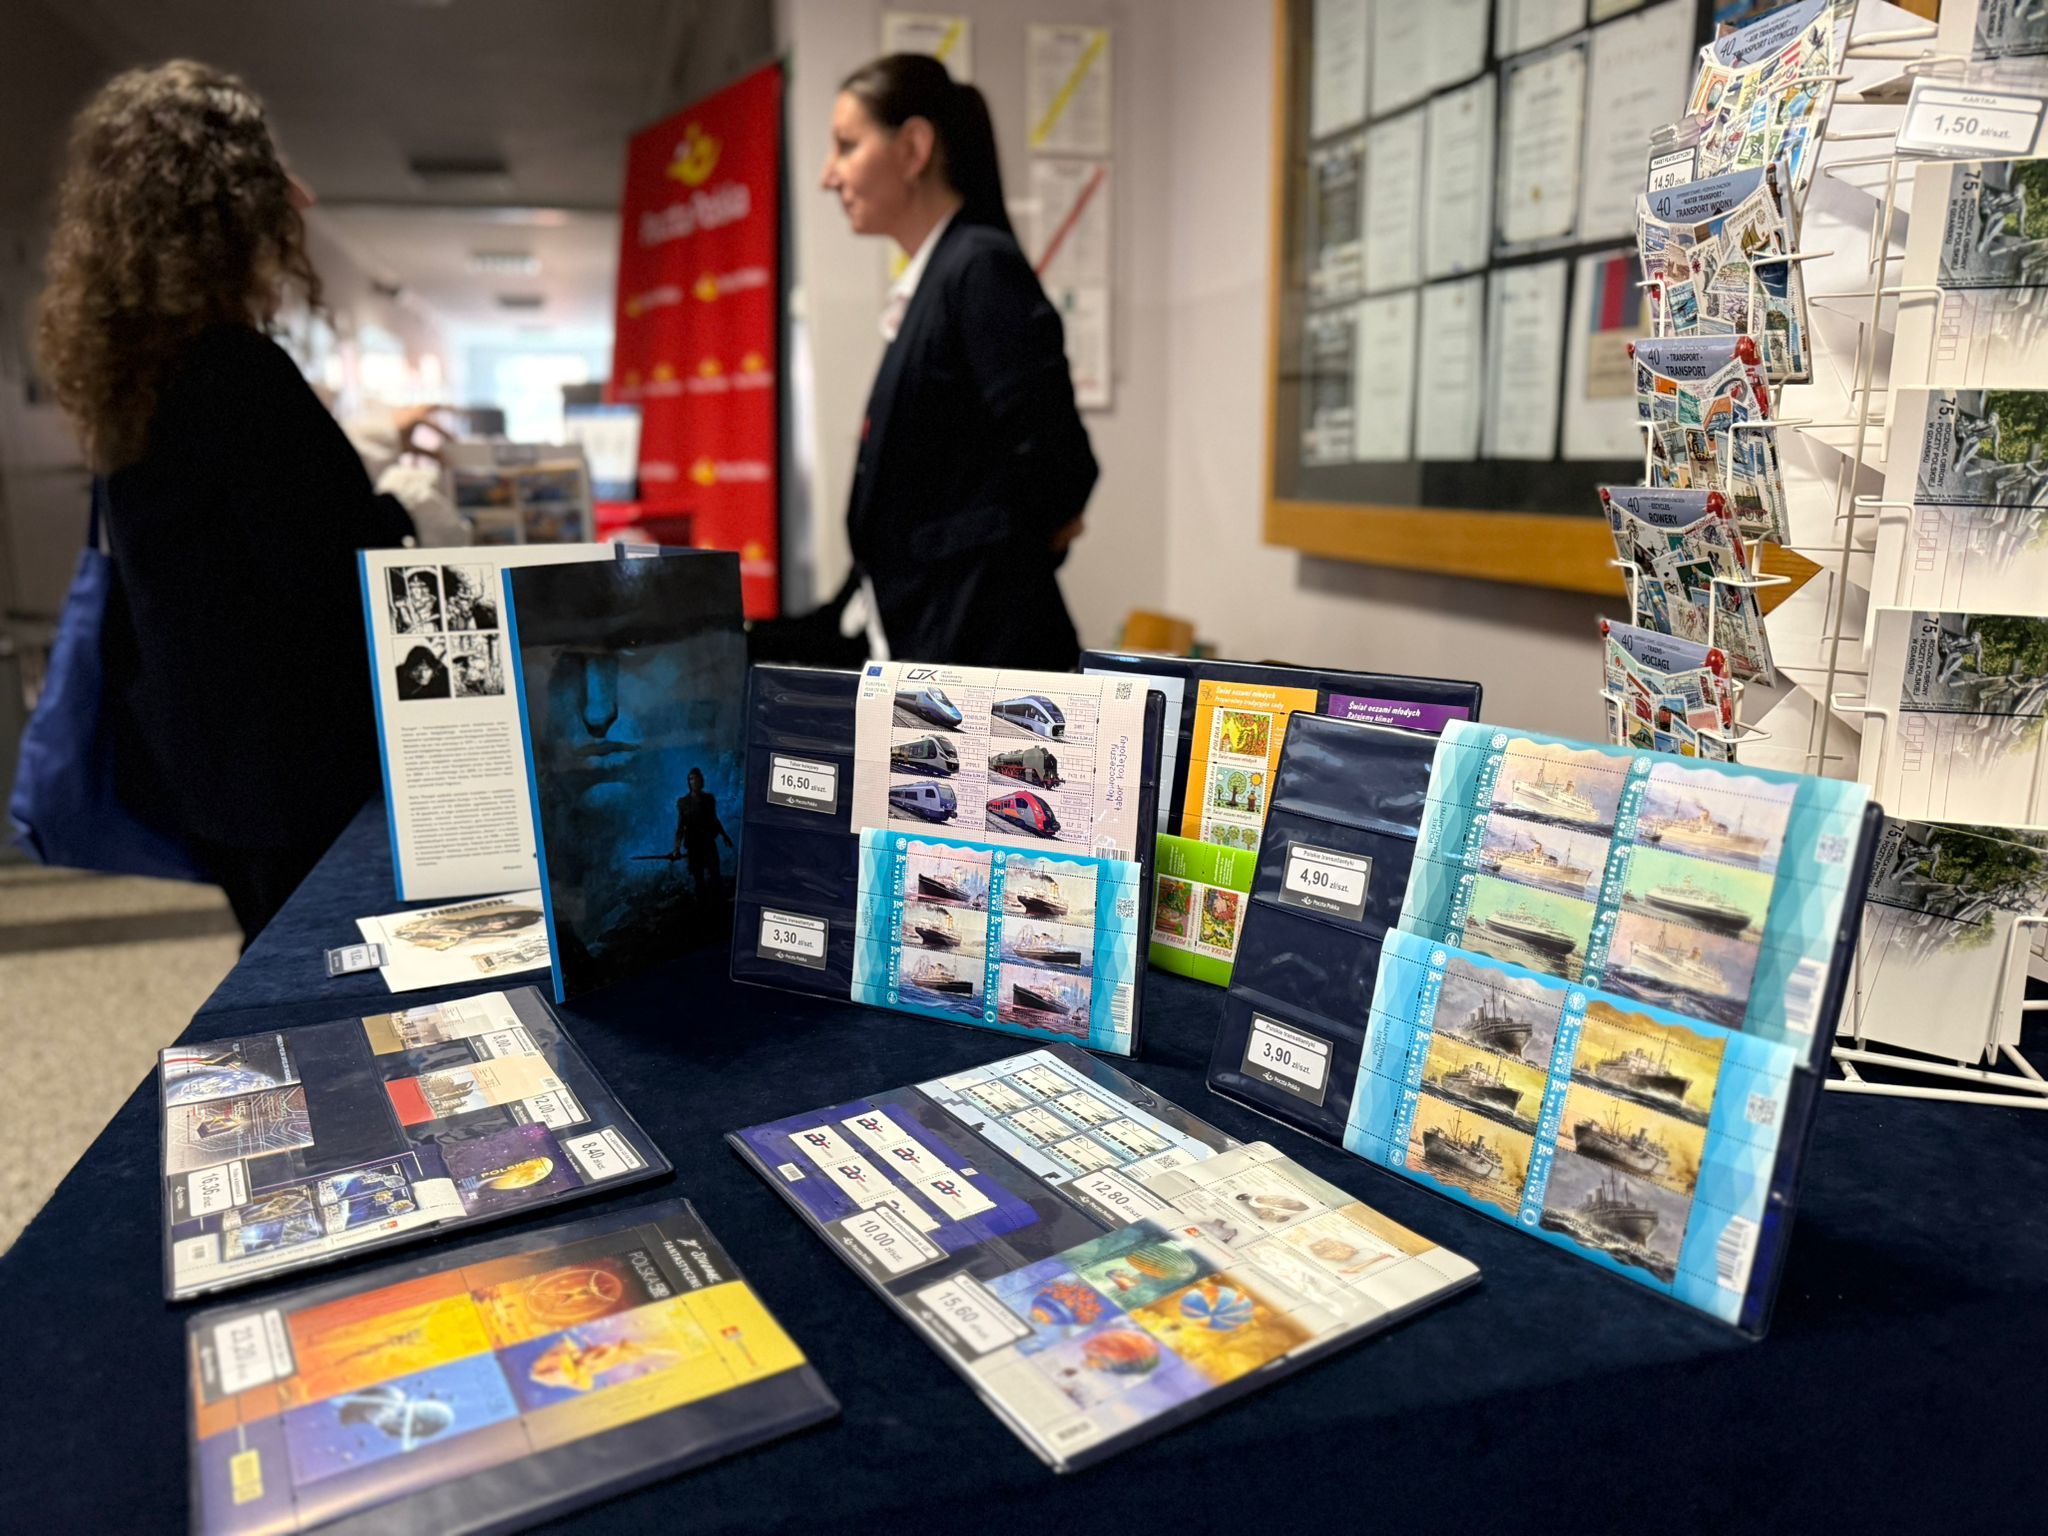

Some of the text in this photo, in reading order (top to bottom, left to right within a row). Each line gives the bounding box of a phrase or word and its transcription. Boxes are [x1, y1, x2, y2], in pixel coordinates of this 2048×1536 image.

[1720, 37, 1736, 58] 40
[1767, 25, 1799, 48] LOTNICZY
[1934, 115, 1979, 135] 1,50
[1961, 170, 1981, 195] 75.
[1657, 196, 1671, 217] 40
[1675, 199, 1734, 218] TRANSPORT WODNY
[1683, 191, 1722, 206] WATER TRANSPORT
[1647, 348, 1660, 366] 40
[1670, 353, 1700, 362] TRANSPORT
[1665, 366, 1707, 377] TRANSPORT
[1939, 397, 1956, 420] 75.
[1928, 422, 1944, 488] POCZTY POLSKIEJ
[1627, 497, 1640, 514] 40
[1648, 512, 1678, 525] ROWERY
[1921, 617, 1940, 637] 75.
[1621, 634, 1634, 652] 40
[1348, 700, 1421, 718] Świat oczami młodych
[780, 773, 810, 790] 16,50
[1105, 743, 1119, 802] Nowoczesny
[1114, 735, 1129, 811] tabor kolejowy
[1476, 767, 1491, 807] POLSKA
[1617, 793, 1634, 838] POLSKA
[1428, 816, 1438, 844] POLSKIE
[1432, 806, 1447, 858] TRANSATLANTYKI
[1886, 824, 1906, 841] 75.
[1463, 826, 1477, 867] POLSKA
[1300, 868, 1349, 893] 4,90 zł/szt.
[1604, 858, 1619, 902] POLSKA
[1327, 903, 1340, 911] Polska
[1450, 886, 1465, 926] POLSKA
[773, 929, 797, 945] 3,30
[1418, 984, 1433, 1024] POLSKA
[1263, 1042, 1311, 1075] 3,90 zł/szt.
[1406, 1043, 1420, 1084] POLSKA
[1554, 1029, 1569, 1073] POLSKA
[534, 1094, 556, 1115] 12,00
[1541, 1093, 1556, 1137] POLSKA
[1395, 1103, 1408, 1143] POLSKA
[581, 1141, 605, 1159] 8,40
[480, 1157, 535, 1179] POLSKA
[1527, 1158, 1542, 1201] POLSKA
[201, 1172, 220, 1195] 16,36
[1091, 1180, 1130, 1205] 12,80
[859, 1219, 895, 1247] 10,00
[629, 1250, 661, 1284] POLSKA
[663, 1240, 703, 1289] FANTASTYCZNE
[938, 1291, 979, 1322] 15,60
